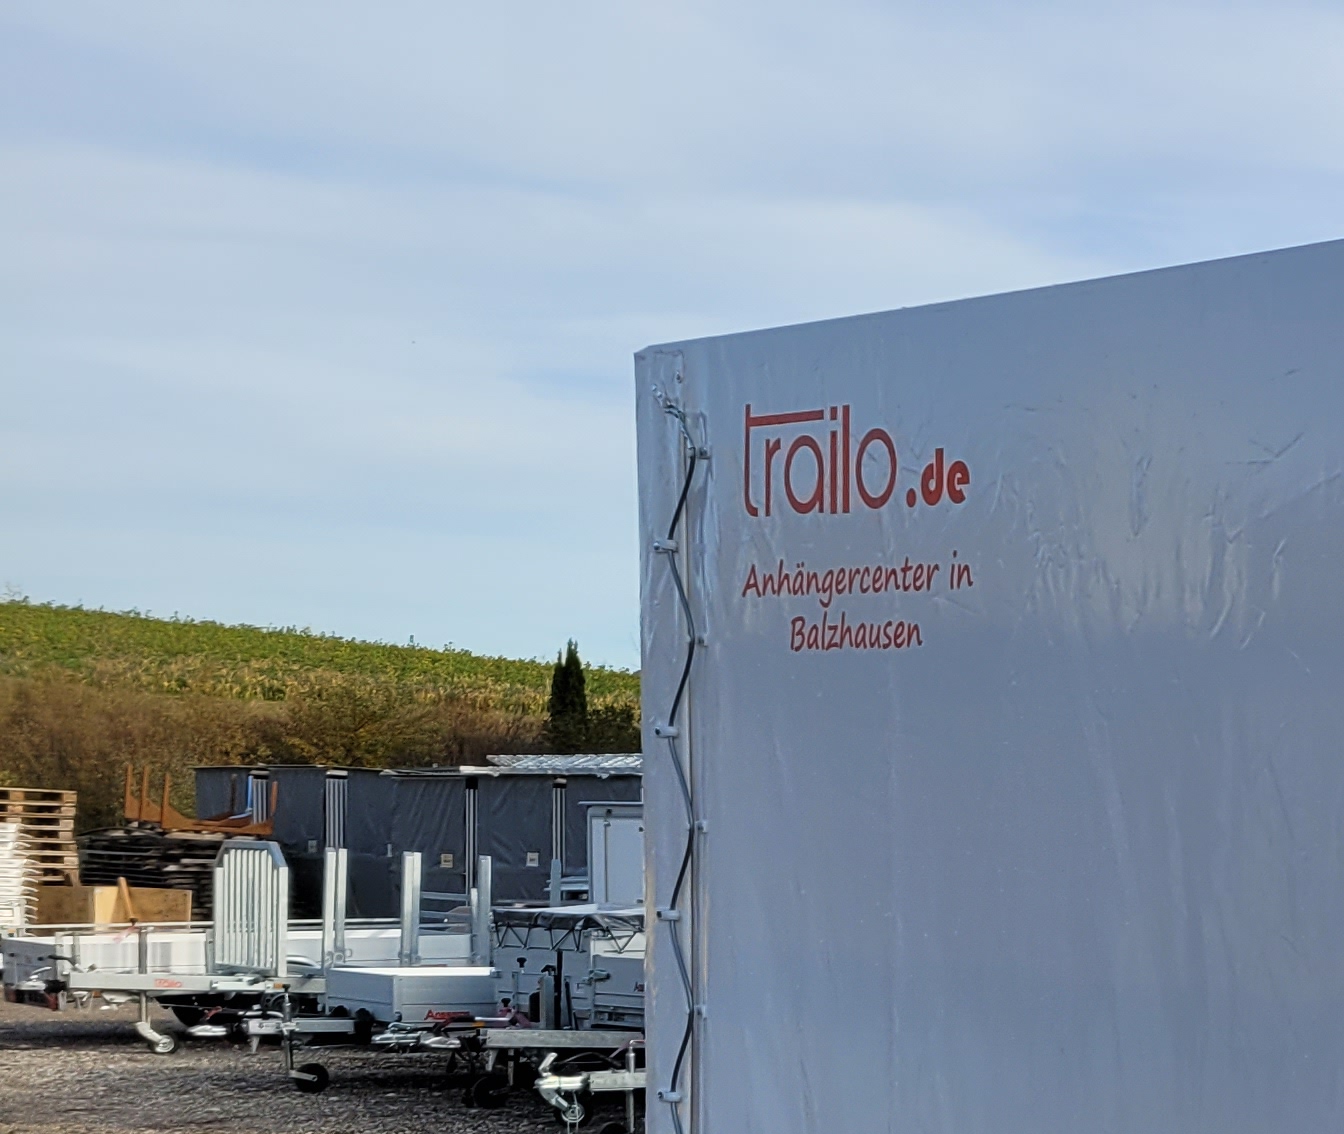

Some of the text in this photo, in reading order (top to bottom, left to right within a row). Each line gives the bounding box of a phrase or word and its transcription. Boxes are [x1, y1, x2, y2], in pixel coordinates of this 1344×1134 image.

[744, 403, 971, 518] trailo.de
[741, 549, 974, 609] Anhängercenter in
[789, 610, 924, 653] Balzhausen
